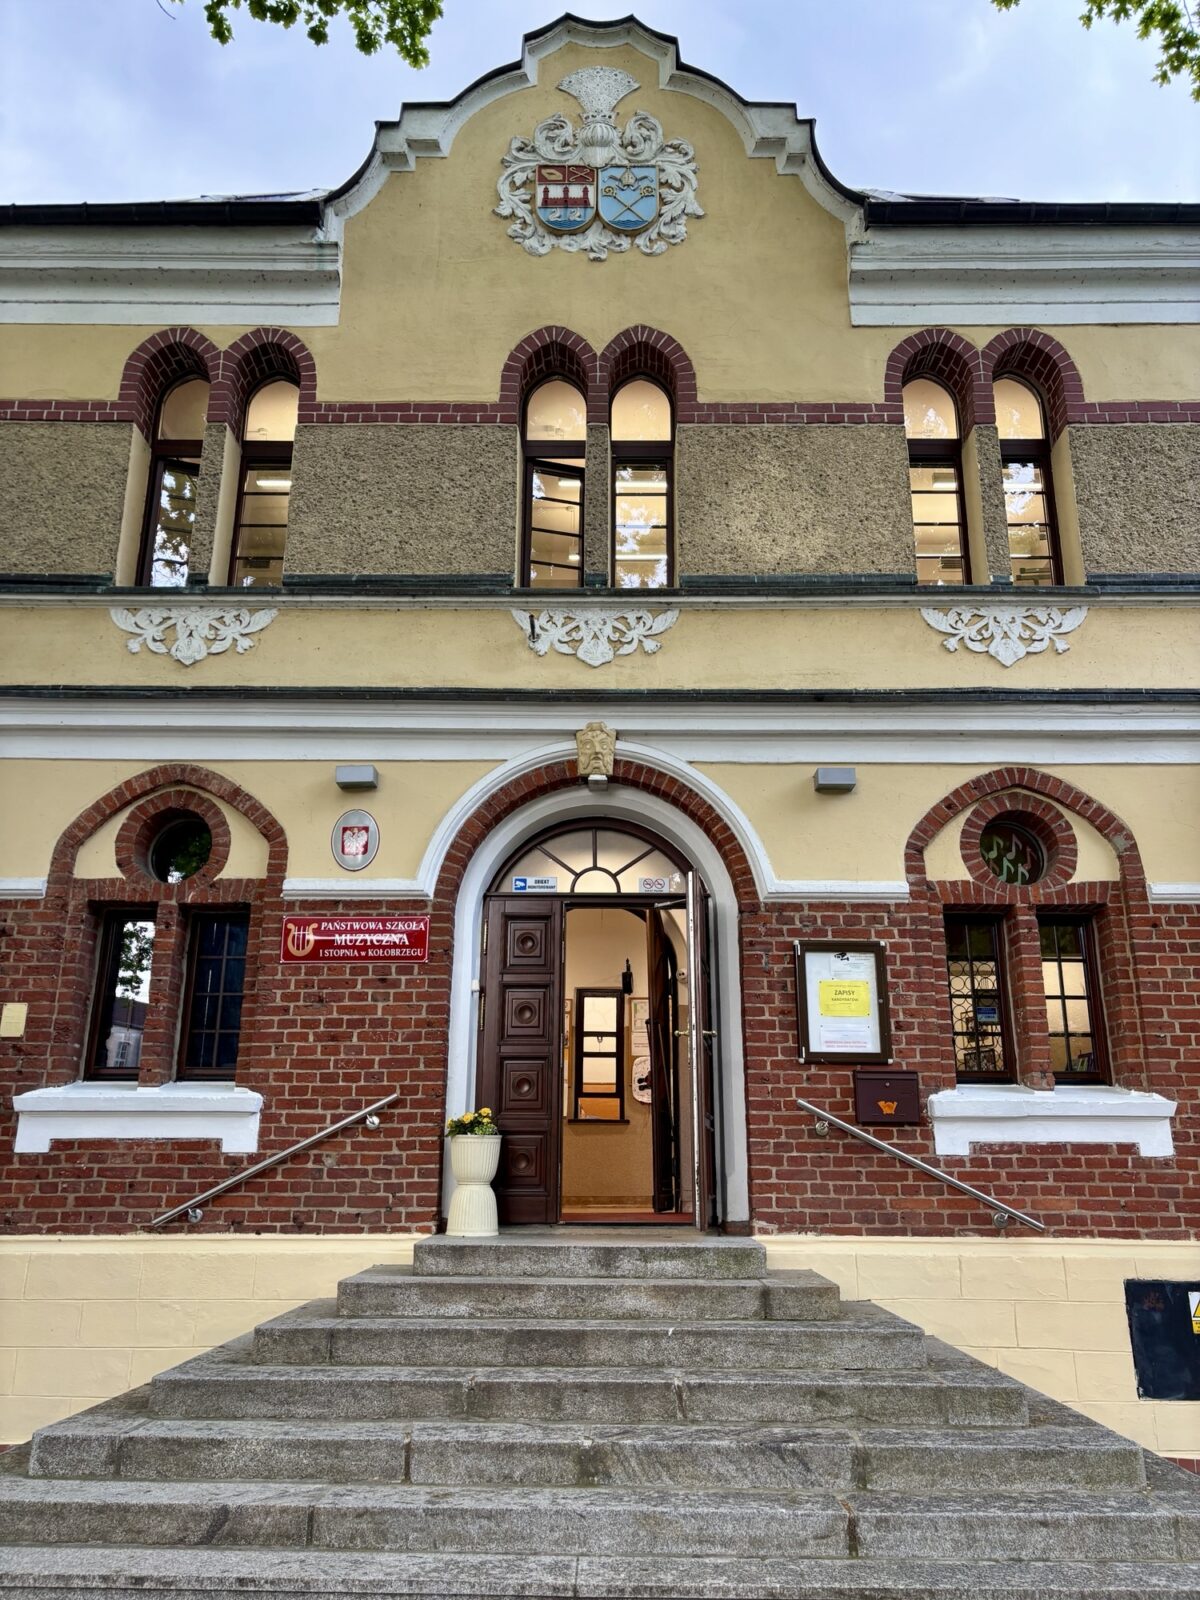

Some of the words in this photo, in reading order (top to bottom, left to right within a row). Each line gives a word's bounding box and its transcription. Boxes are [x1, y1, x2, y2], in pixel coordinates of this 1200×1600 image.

[321, 919, 383, 931] PAŃSTWOWA
[385, 921, 426, 931] SZKOŁA
[333, 933, 410, 946] MUZYCZNA
[319, 949, 323, 957] I
[324, 948, 359, 957] STOPNIA
[368, 948, 424, 957] KOŁOBRZEGU
